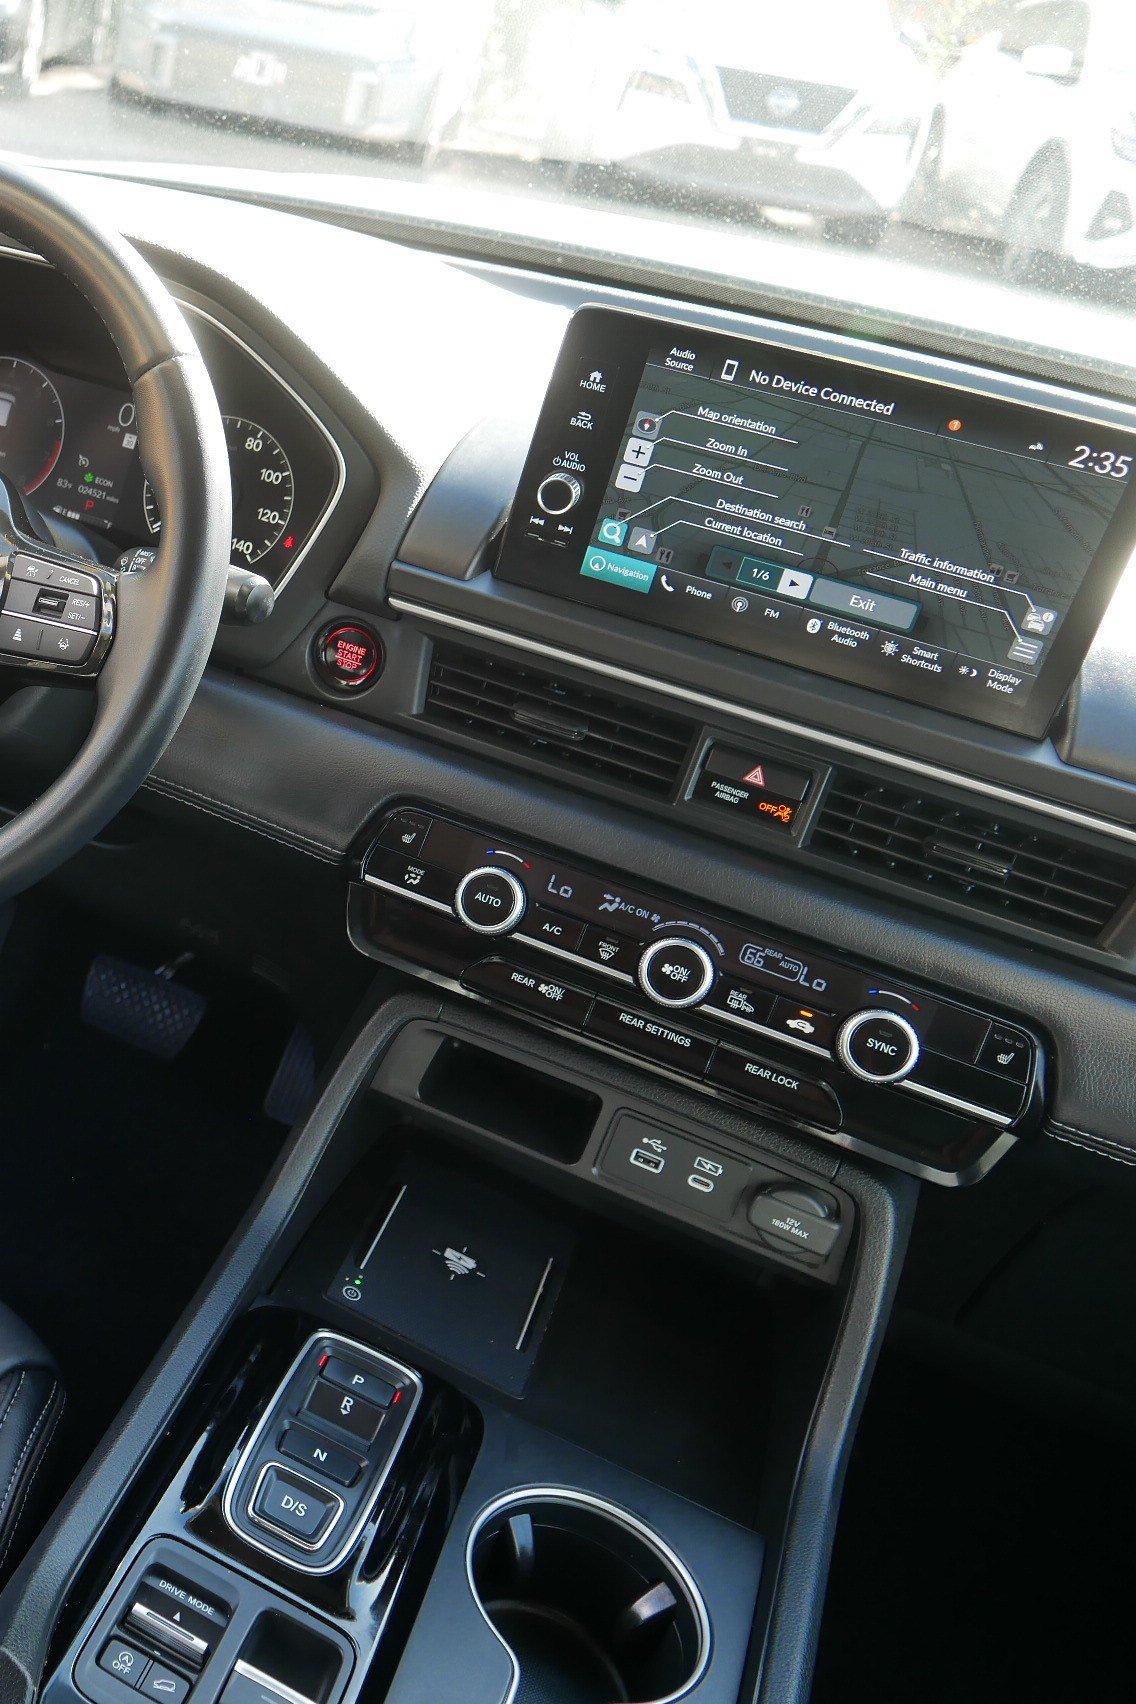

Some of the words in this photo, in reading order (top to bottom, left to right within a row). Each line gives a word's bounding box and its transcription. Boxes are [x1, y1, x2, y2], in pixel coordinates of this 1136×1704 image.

[670, 348, 696, 360] Audio
[665, 358, 694, 371] Source
[580, 380, 606, 393] HOME
[750, 369, 769, 385] No
[772, 374, 818, 397] Device
[821, 388, 895, 416] Connected
[570, 417, 594, 430] BACK
[697, 406, 720, 421] Map
[722, 411, 776, 434] orientation
[244, 437, 262, 452] 80
[706, 438, 736, 454] Zoom
[737, 445, 748, 458] In
[565, 451, 580, 462] VOL
[1068, 445, 1133, 478] 2:35
[562, 460, 586, 472] AUDIO
[94, 476, 114, 488] ECON
[260, 468, 282, 484] 100
[692, 464, 722, 479] Zoom
[723, 472, 744, 485] Out
[78, 485, 106, 500] 024521
[85, 500, 95, 511] P
[257, 508, 279, 524] 120
[716, 499, 773, 522] Destination
[774, 515, 806, 531] search
[704, 518, 742, 536] Current
[742, 526, 782, 546] location
[231, 537, 253, 555] 140
[607, 562, 650, 581] Navigation
[900, 548, 932, 566] Traffic
[932, 557, 994, 583] information
[58, 576, 80, 586] CANCEL
[752, 568, 770, 580] 1/6
[686, 585, 712, 600] Phone
[909, 573, 936, 590] Main
[936, 581, 968, 598] menu
[849, 595, 876, 612] Exit
[764, 608, 780, 619] FM
[827, 621, 870, 641] Bluetooth
[337, 640, 366, 656] ENGINE
[831, 634, 858, 648] Audio
[337, 649, 362, 663] START
[912, 646, 938, 660] Smart
[336, 658, 358, 670] STOP
[900, 654, 943, 674] Shortcuts
[988, 668, 1022, 686] Display
[986, 680, 1014, 694] Mode
[711, 781, 749, 800] PASSENGER
[714, 791, 740, 804] AIRBAG
[758, 802, 778, 814] OFF
[407, 866, 426, 876] MODE
[547, 874, 574, 899] Lo
[474, 892, 502, 908] AUTO
[618, 902, 634, 914] A/C
[636, 908, 650, 919] ON
[542, 922, 563, 936] A/C
[598, 941, 620, 953] FRONT
[764, 948, 784, 960] REAR
[744, 948, 764, 968] 66
[673, 965, 692, 977] ON/
[779, 960, 800, 972] AUTO
[510, 972, 536, 989] REAR
[548, 984, 566, 997] ON/
[670, 972, 689, 984] OFF
[798, 966, 827, 992] Lo
[545, 990, 564, 1002] OFF
[730, 990, 748, 1000] REAR
[619, 1012, 644, 1030] REAR
[645, 1023, 692, 1048] SETTINGS
[866, 1038, 898, 1056] SYNC
[744, 1062, 770, 1080] REAR
[772, 1072, 800, 1090] LOCK
[771, 1218, 792, 1234] 180W
[790, 1227, 810, 1240] MAX
[786, 1216, 802, 1228] 12V
[352, 1374, 364, 1385] P
[341, 1396, 354, 1411] R
[313, 1448, 328, 1462] N
[281, 1494, 308, 1517] D/S
[159, 1579, 187, 1601] DRIVE
[188, 1595, 216, 1616] MODE
[112, 1660, 131, 1675] OFF
